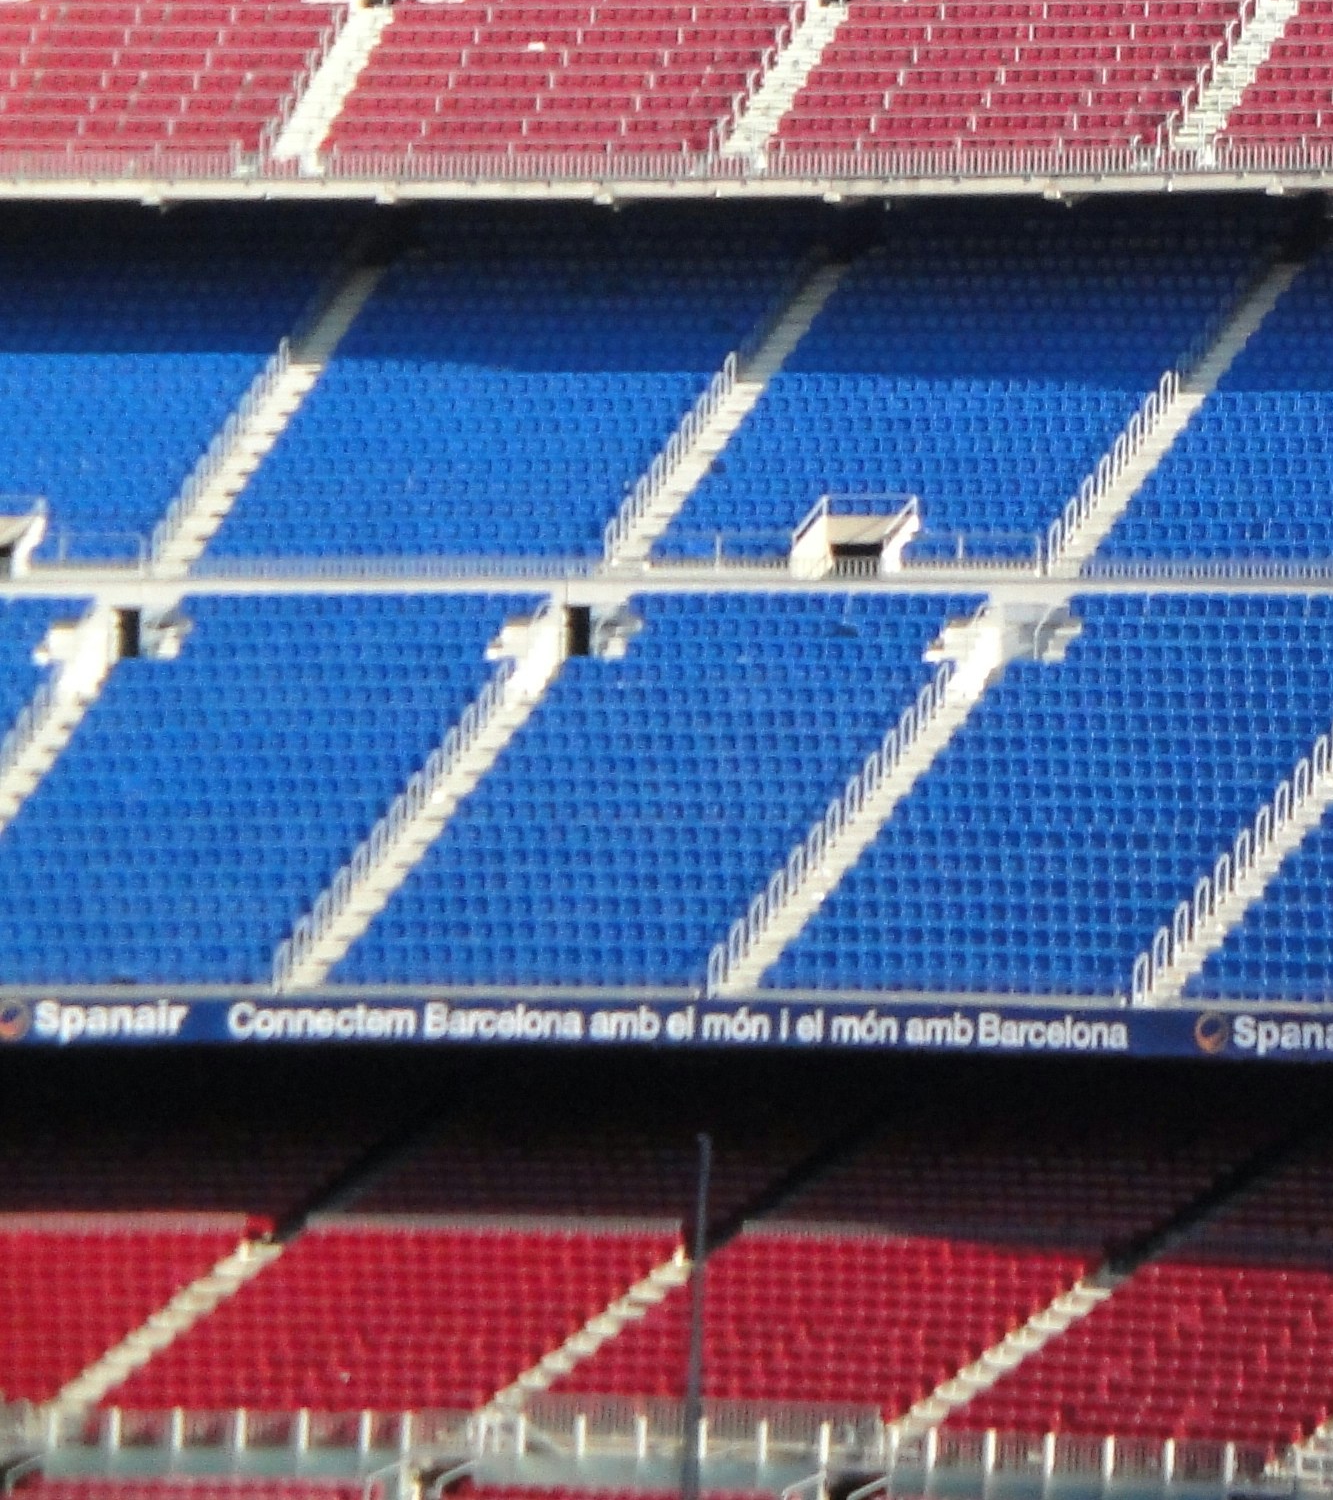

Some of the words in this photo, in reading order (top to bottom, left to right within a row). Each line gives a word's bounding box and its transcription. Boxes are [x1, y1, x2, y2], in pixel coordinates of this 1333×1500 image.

[35, 998, 189, 1045] Spanair
[227, 1002, 415, 1041] Connectem
[424, 1002, 582, 1040] Barcelona
[590, 1003, 659, 1039] amb
[667, 1005, 695, 1039] el
[703, 1007, 769, 1042] món
[797, 1010, 824, 1043] el
[831, 1010, 898, 1045] món
[905, 1011, 974, 1046] amb
[978, 1013, 1128, 1050] Barcelona
